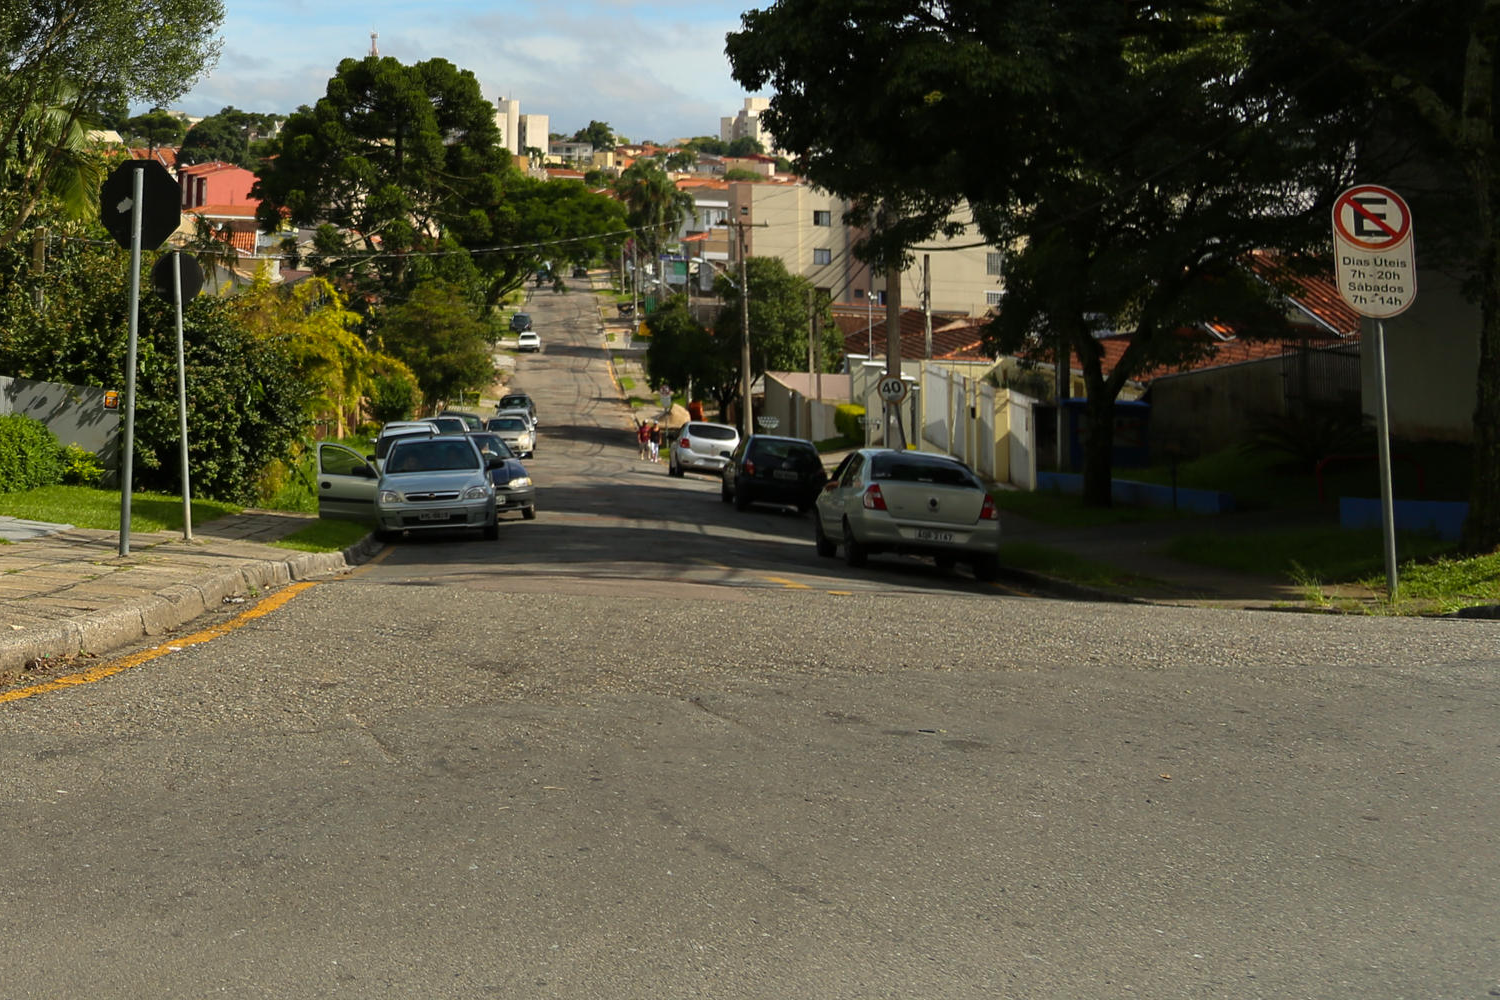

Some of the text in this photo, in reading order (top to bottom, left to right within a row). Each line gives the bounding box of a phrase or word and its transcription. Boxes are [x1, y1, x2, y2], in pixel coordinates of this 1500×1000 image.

[1342, 255, 1407, 268] Dias Úteis
[1350, 270, 1366, 279] 7h
[1377, 270, 1400, 280] 20h
[1348, 282, 1404, 293] Sábados
[1352, 294, 1367, 304] 7h
[1380, 296, 1402, 306] 14h
[882, 381, 901, 394] 40
